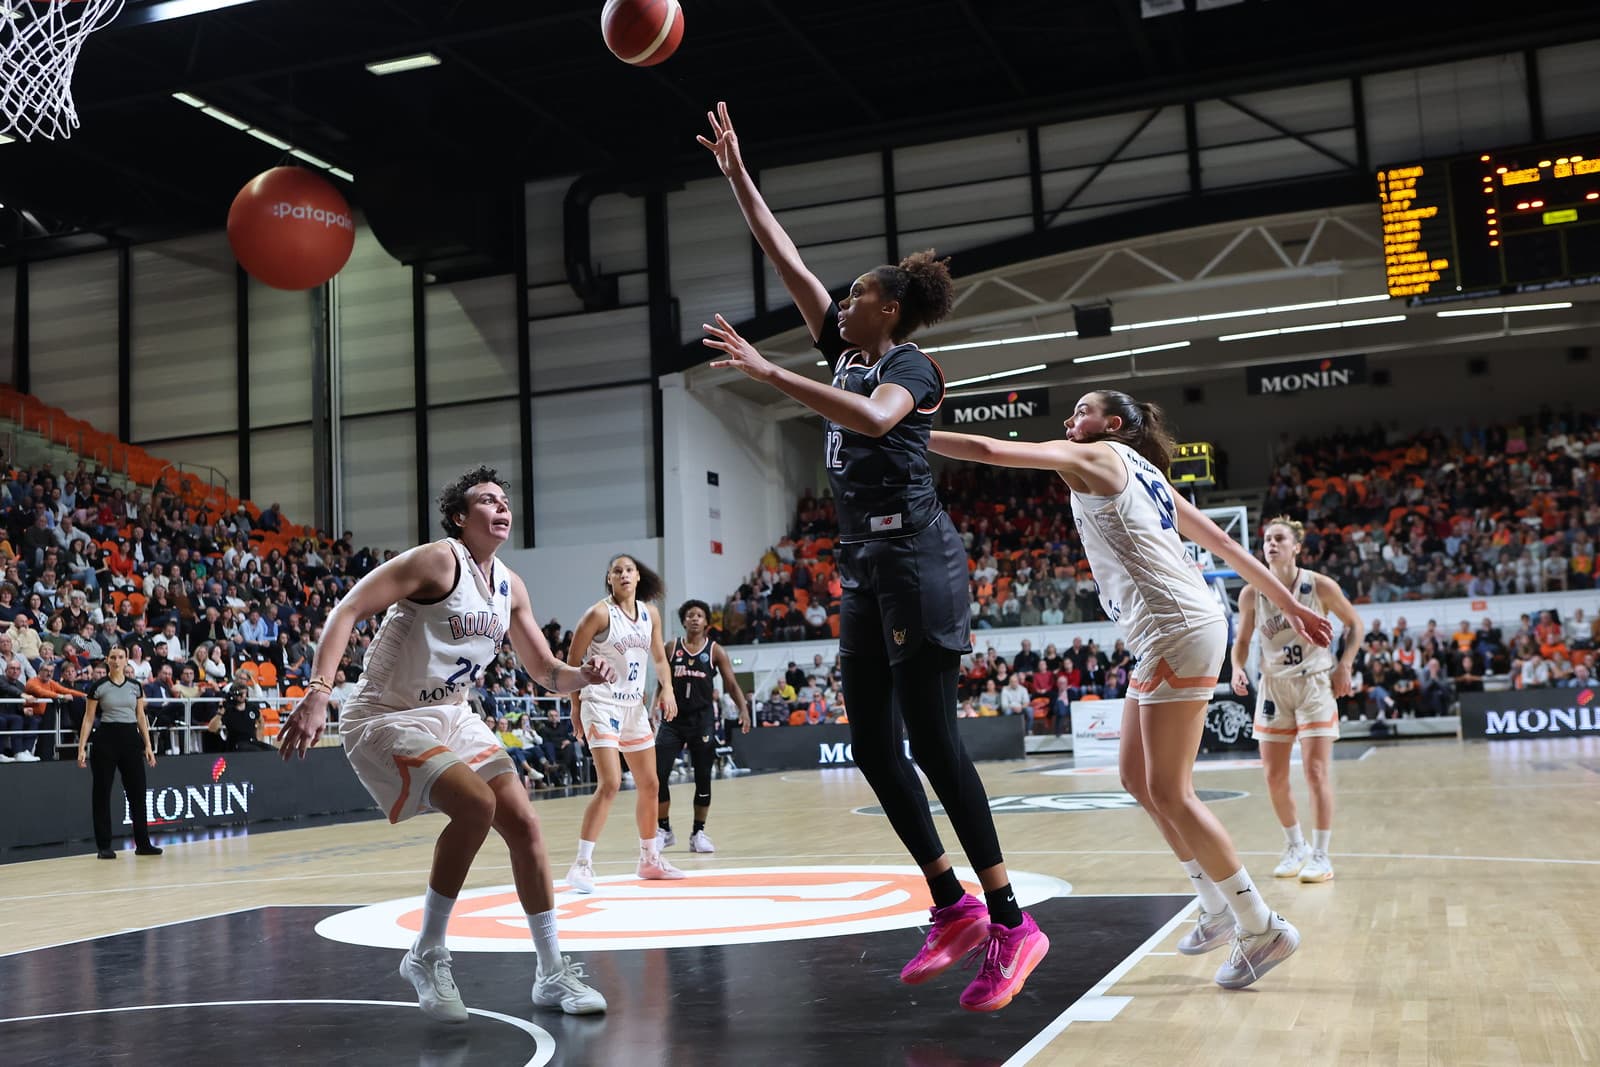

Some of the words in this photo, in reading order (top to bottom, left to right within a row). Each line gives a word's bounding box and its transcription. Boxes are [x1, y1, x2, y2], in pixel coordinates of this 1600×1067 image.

[1261, 369, 1349, 393] MONIN
[953, 401, 1033, 424] MONIN
[826, 431, 843, 468] 12
[1283, 645, 1304, 666] 39
[628, 662, 640, 681] 26
[685, 682, 691, 699] 1
